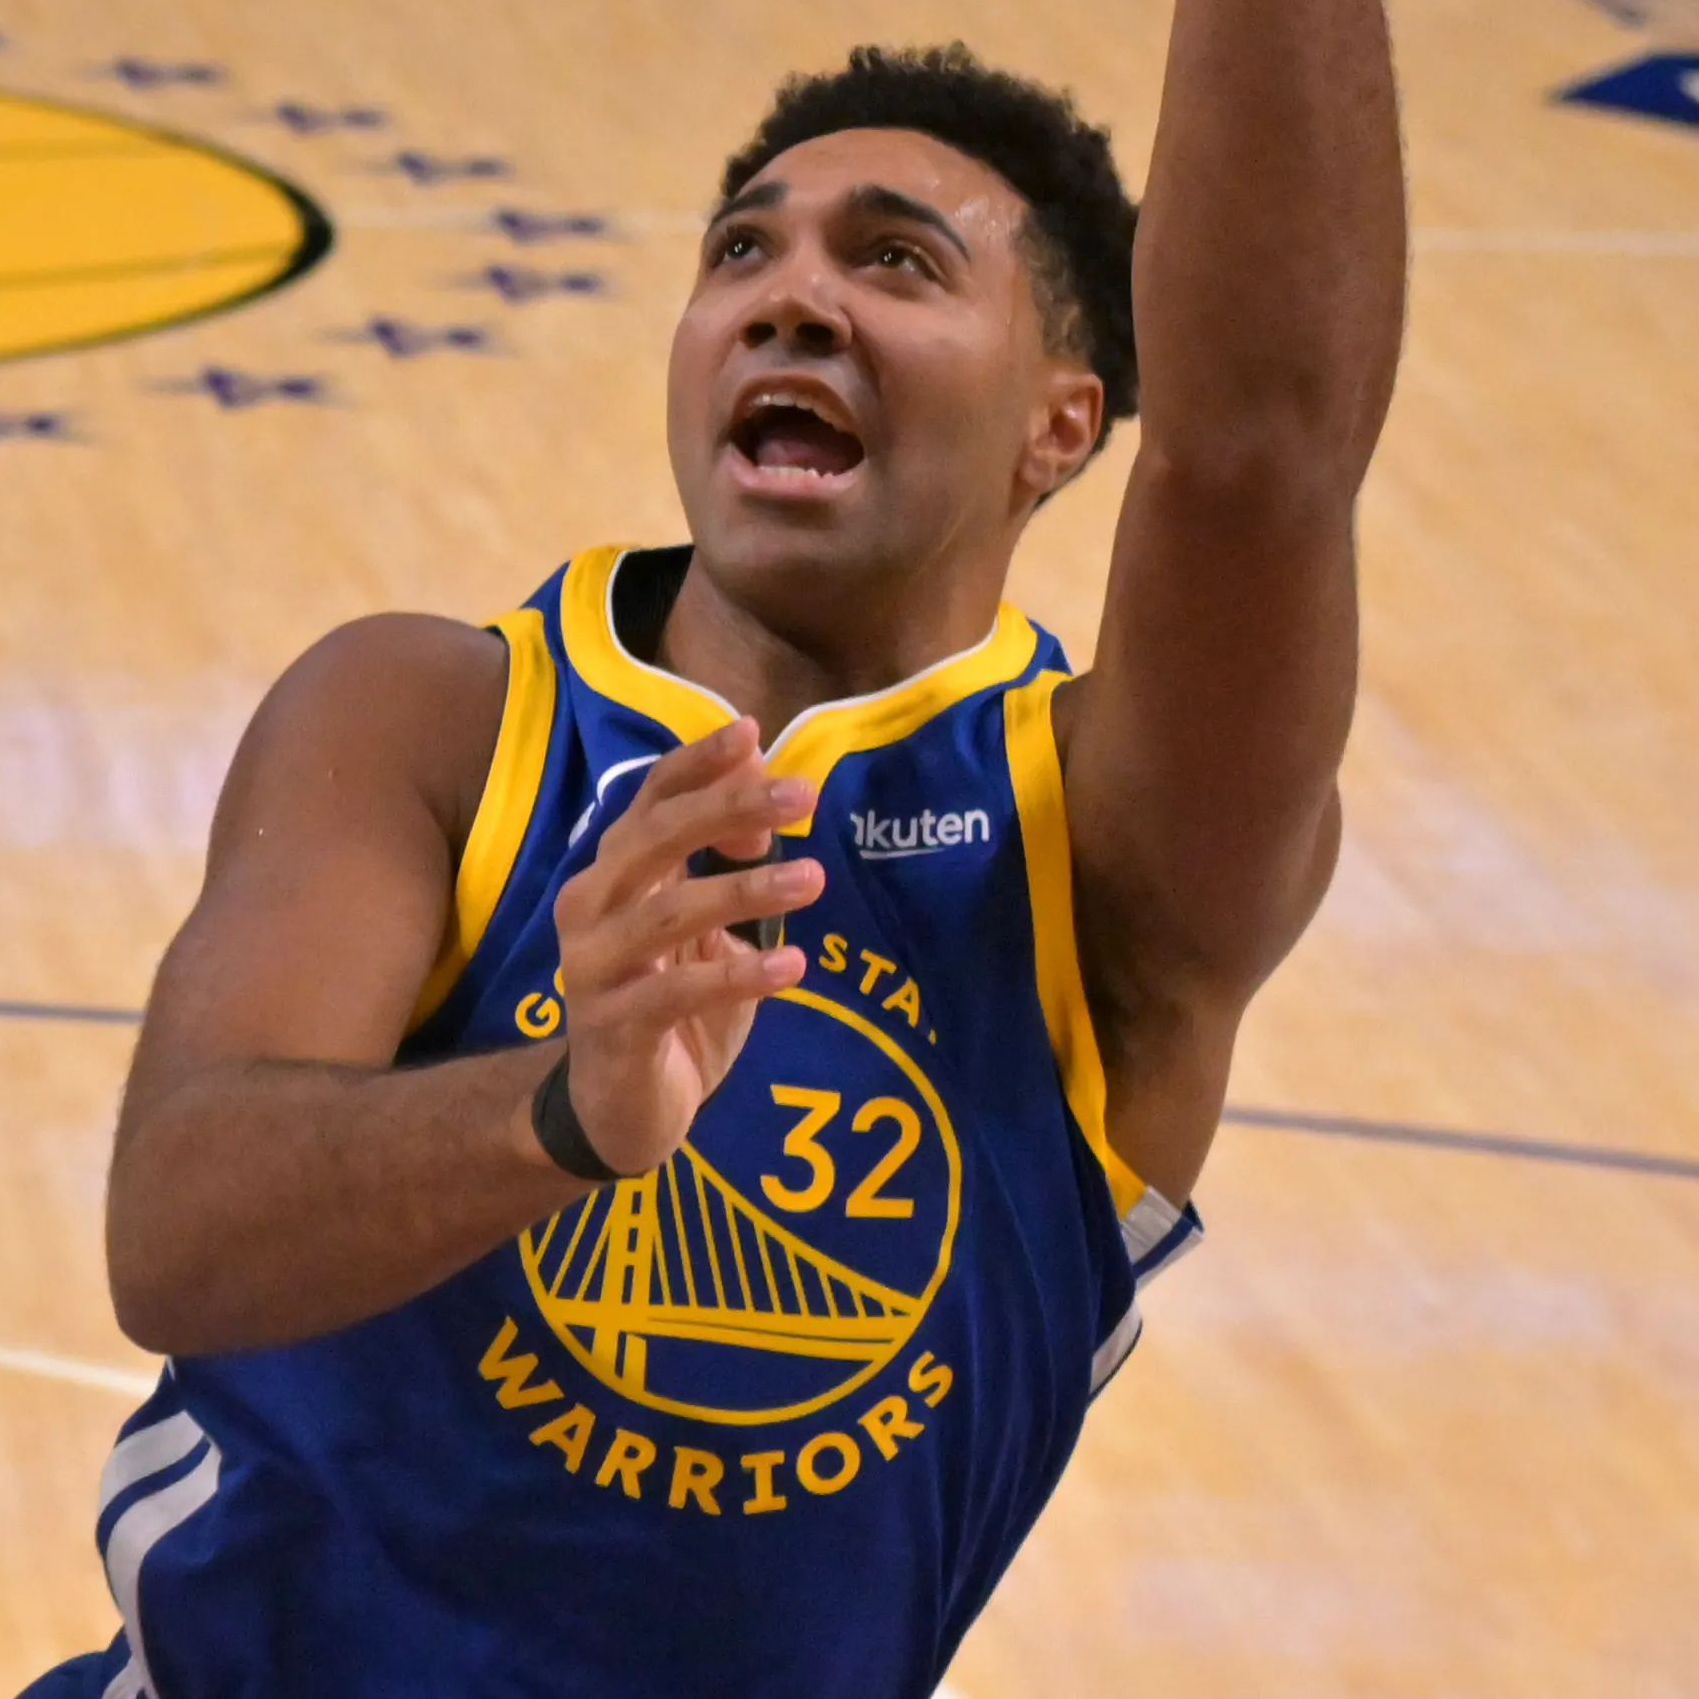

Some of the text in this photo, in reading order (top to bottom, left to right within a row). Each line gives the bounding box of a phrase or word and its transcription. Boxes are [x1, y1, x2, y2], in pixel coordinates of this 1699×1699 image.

[819, 933, 937, 1044] STA
[759, 1084, 923, 1219] 32
[477, 1316, 954, 1515] WARRIORS
